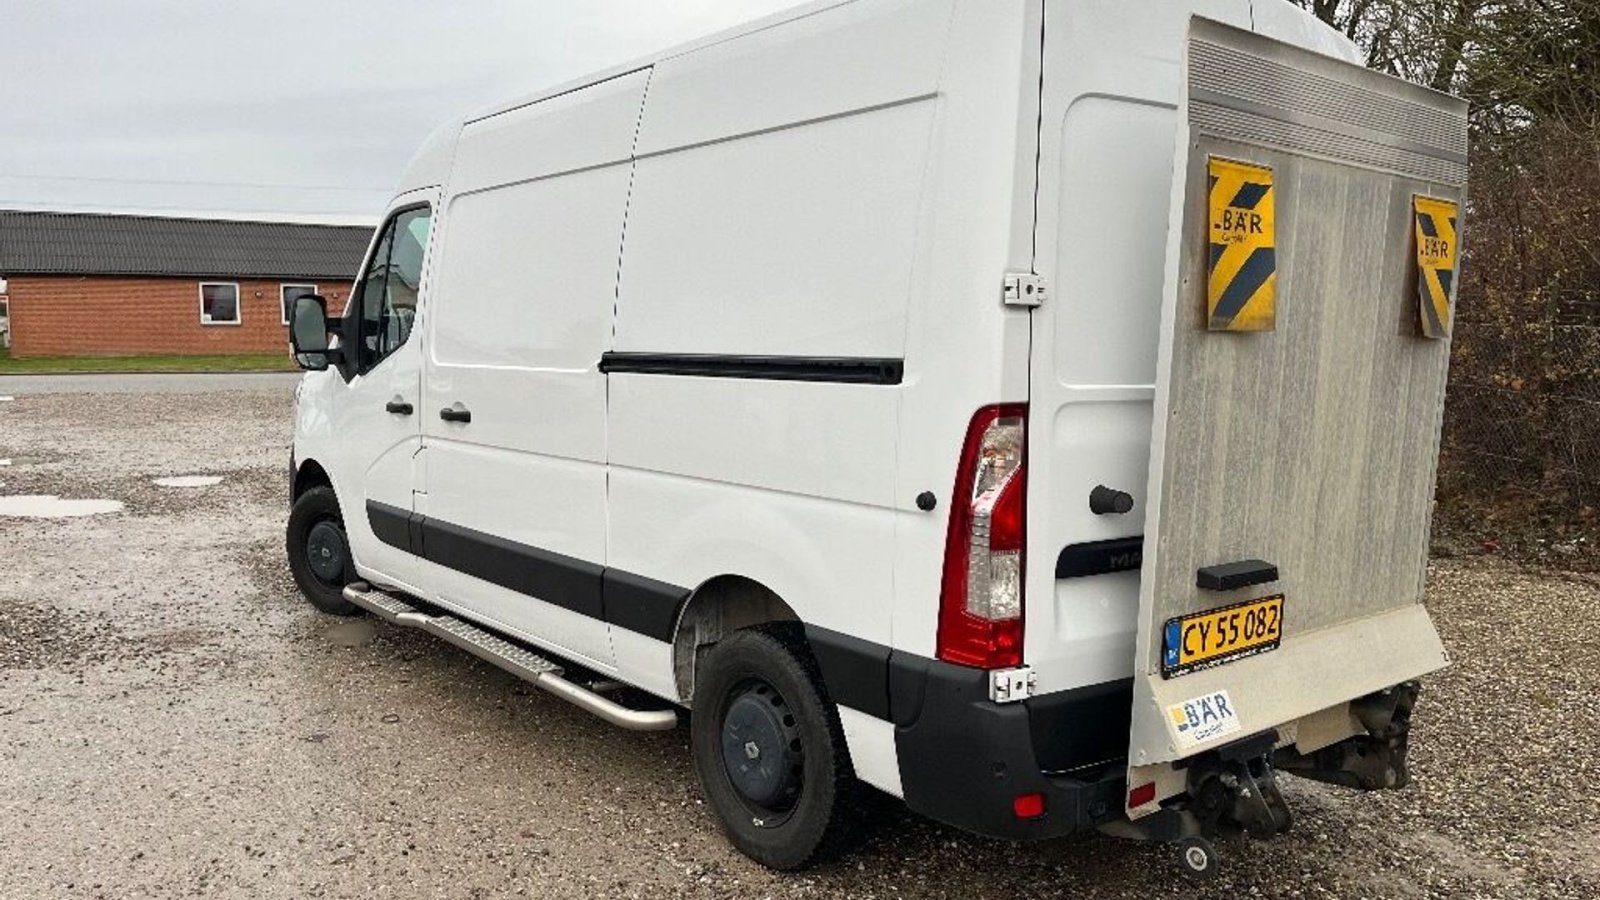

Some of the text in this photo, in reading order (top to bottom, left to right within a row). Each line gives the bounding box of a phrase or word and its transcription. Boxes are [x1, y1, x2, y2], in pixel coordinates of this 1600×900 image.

[1223, 209, 1263, 234] BÄR
[1183, 604, 1278, 656] CY 55 082
[1184, 694, 1232, 728] BÄR
